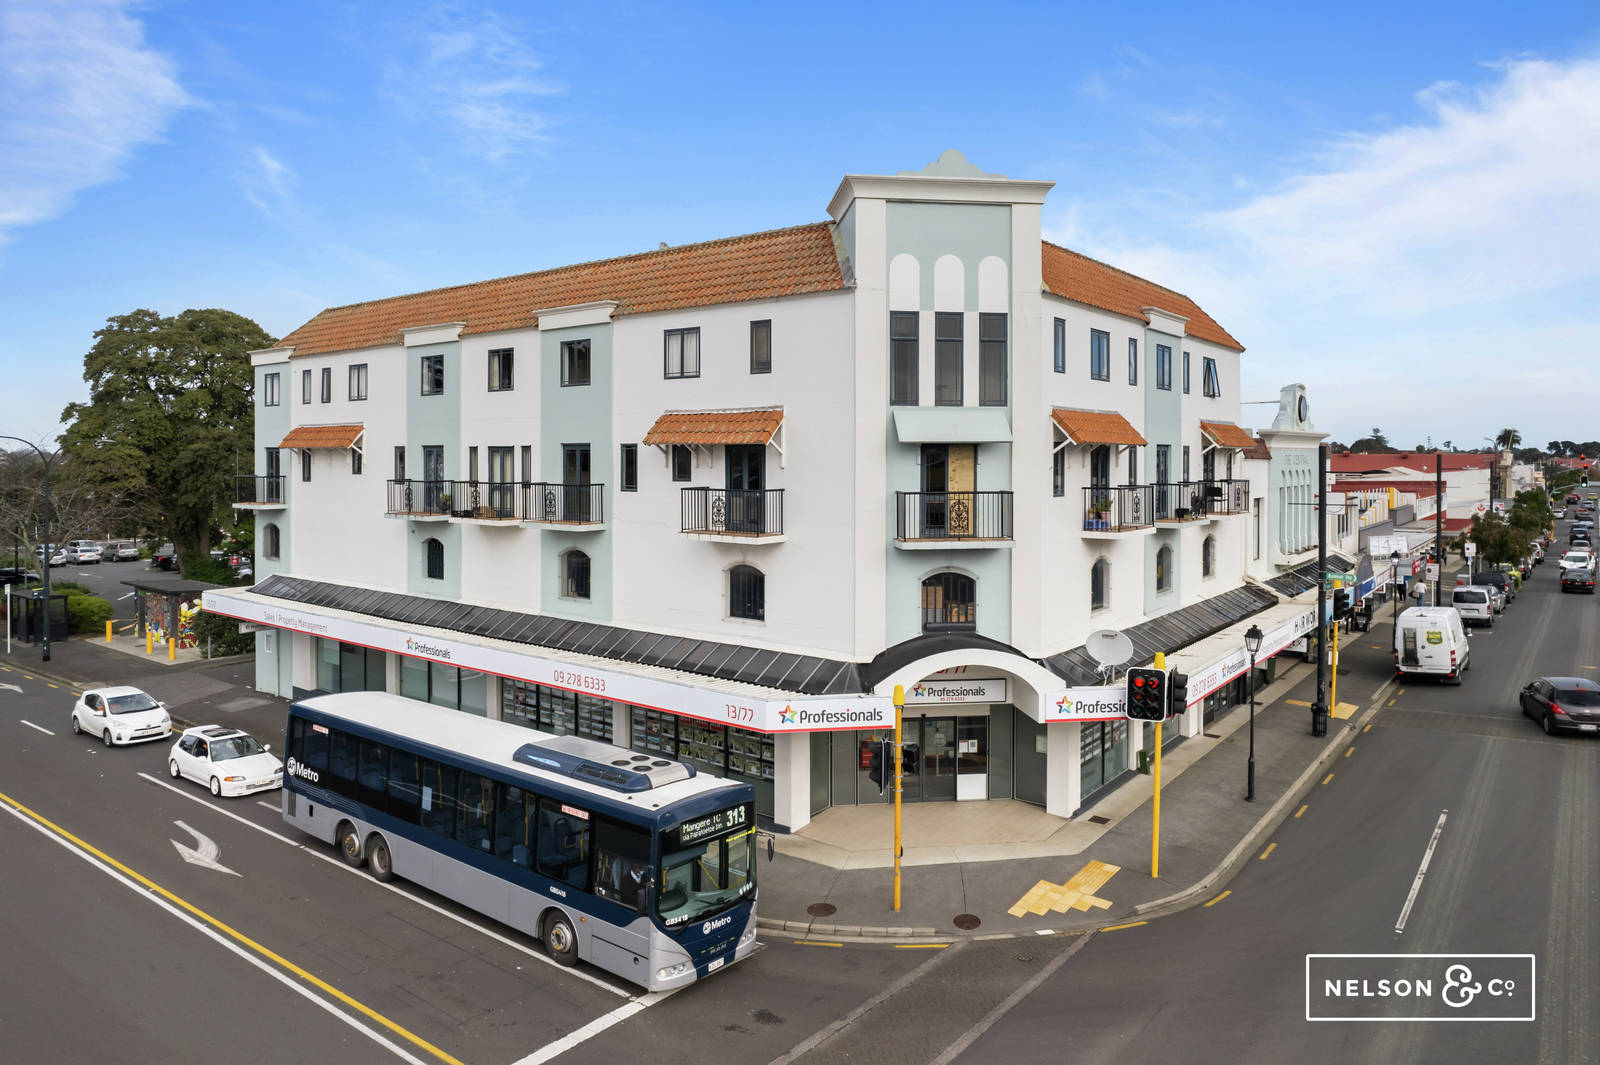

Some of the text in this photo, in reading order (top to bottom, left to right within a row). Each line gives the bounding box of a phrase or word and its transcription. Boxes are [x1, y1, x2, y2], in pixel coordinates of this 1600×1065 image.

[415, 642, 451, 659] Professionals
[553, 670, 606, 692] 09 278 6333
[927, 686, 986, 697] Professionals
[725, 704, 754, 722] 13/77
[800, 708, 883, 724] Professionals
[296, 761, 319, 782] Metro
[726, 805, 745, 827] 313
[682, 819, 711, 834] Mangere
[711, 916, 731, 930] Metro
